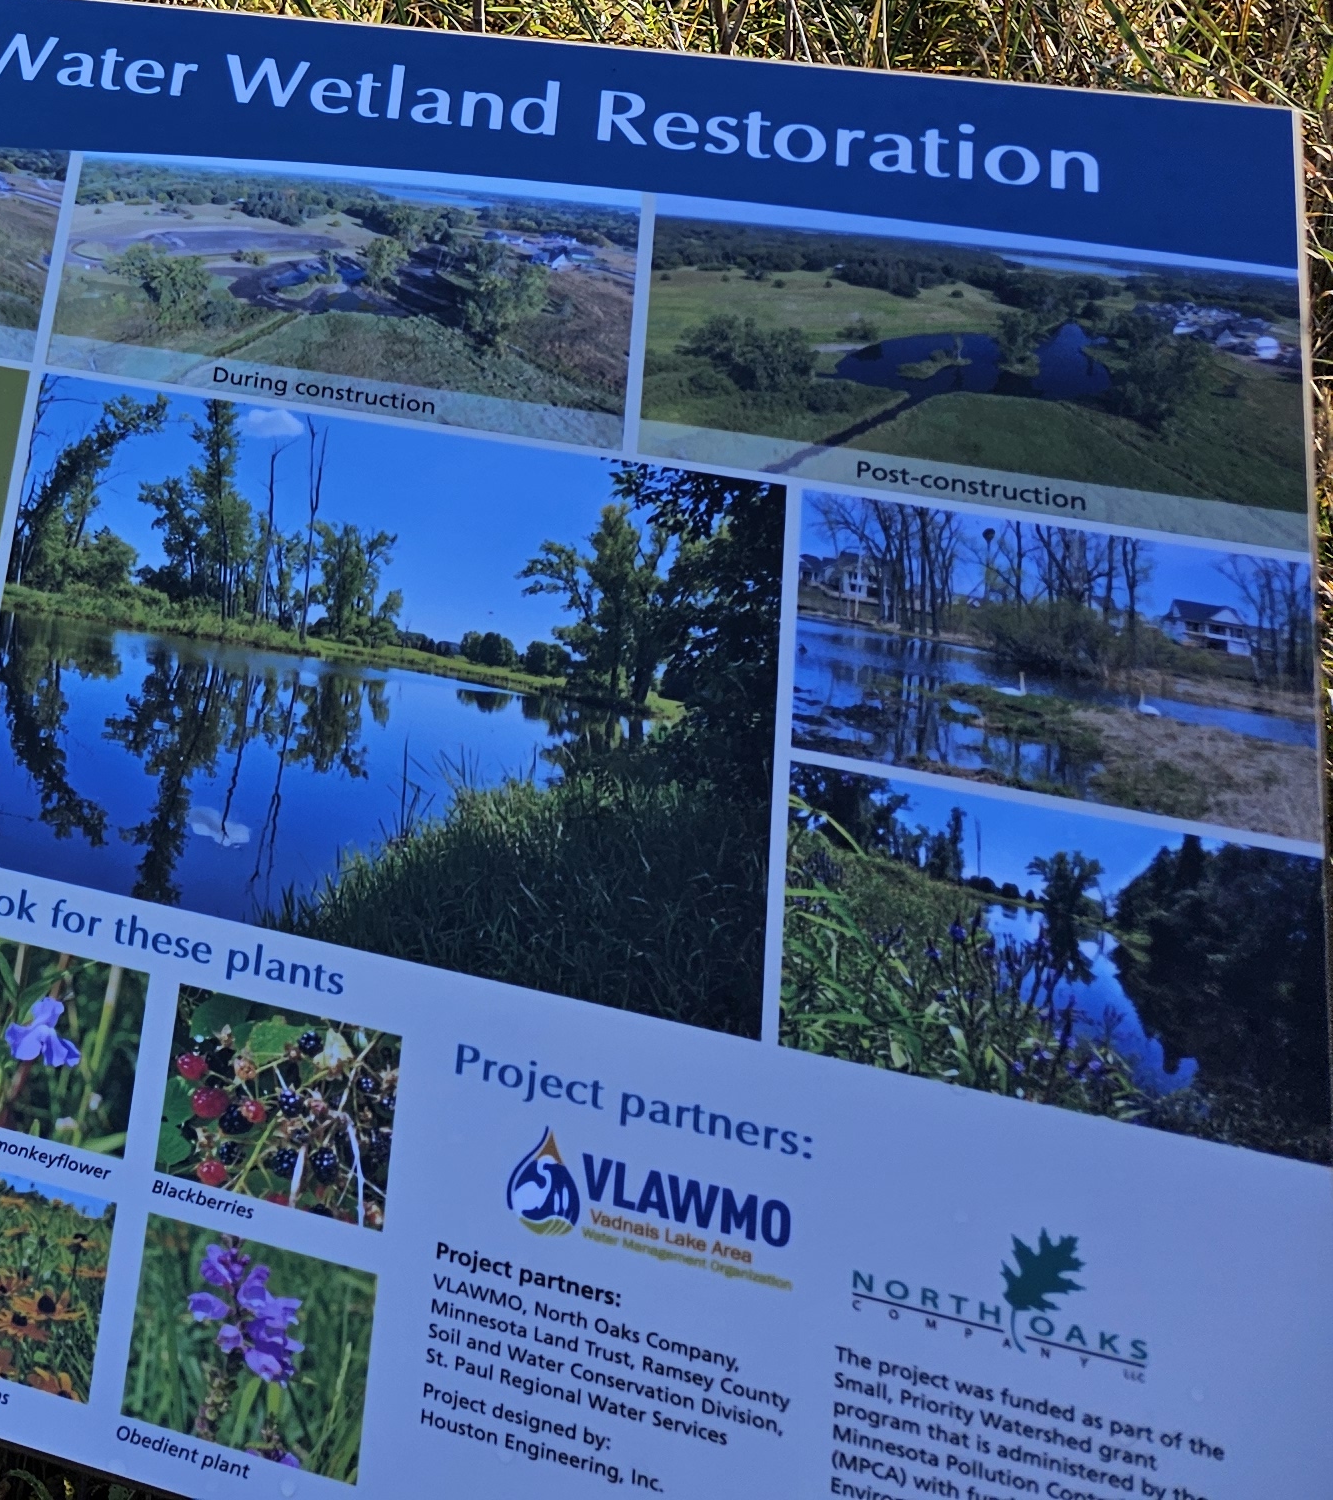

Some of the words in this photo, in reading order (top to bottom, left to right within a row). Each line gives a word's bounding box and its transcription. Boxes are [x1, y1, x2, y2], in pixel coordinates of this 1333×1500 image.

[226, 53, 561, 136] Wetland
[596, 89, 1099, 193] Restoration
[212, 366, 288, 397] During
[295, 382, 435, 415] construction
[856, 460, 1086, 511] Post-construction
[51, 898, 102, 937] for
[115, 914, 212, 964] these
[225, 943, 344, 995] plants
[455, 1043, 604, 1110] Project
[620, 1092, 812, 1160] partners:
[151, 1179, 254, 1219] Blackberries
[582, 1153, 791, 1247] VLAWMO
[436, 1241, 512, 1279] Project
[518, 1268, 621, 1308] partners:
[852, 1269, 1002, 1327] NORTH
[1029, 1315, 1149, 1362] OAKS
[431, 1298, 527, 1338] Minnesota
[534, 1326, 579, 1353] Land
[584, 1339, 635, 1370] Trust,
[642, 1355, 714, 1392] Ramsey
[720, 1377, 790, 1413] County
[433, 1273, 527, 1316] VLAWMO,
[534, 1301, 588, 1329] North
[594, 1317, 640, 1344] Oaks
[646, 1331, 739, 1373] Company,
[423, 1382, 486, 1415] Project
[492, 1403, 577, 1440] designed
[583, 1426, 610, 1452] by:
[426, 1347, 448, 1368] St.
[455, 1355, 494, 1381] Paul
[500, 1368, 581, 1405] Regional
[587, 1392, 647, 1422] Water
[652, 1410, 727, 1446] Services
[428, 1323, 461, 1346] Soil
[466, 1337, 501, 1357] and
[507, 1344, 565, 1374] Water
[570, 1362, 695, 1410] Conservation
[701, 1397, 783, 1437] Division,
[834, 1371, 893, 1404] Small,
[900, 1389, 974, 1427] Priority
[980, 1409, 1092, 1453] Watershed
[1098, 1444, 1156, 1471] grant
[116, 1425, 199, 1464] Obedient
[200, 1453, 250, 1479] plant
[420, 1408, 498, 1445] Houston
[504, 1433, 624, 1484] Engineering,
[631, 1468, 664, 1493] Inc.
